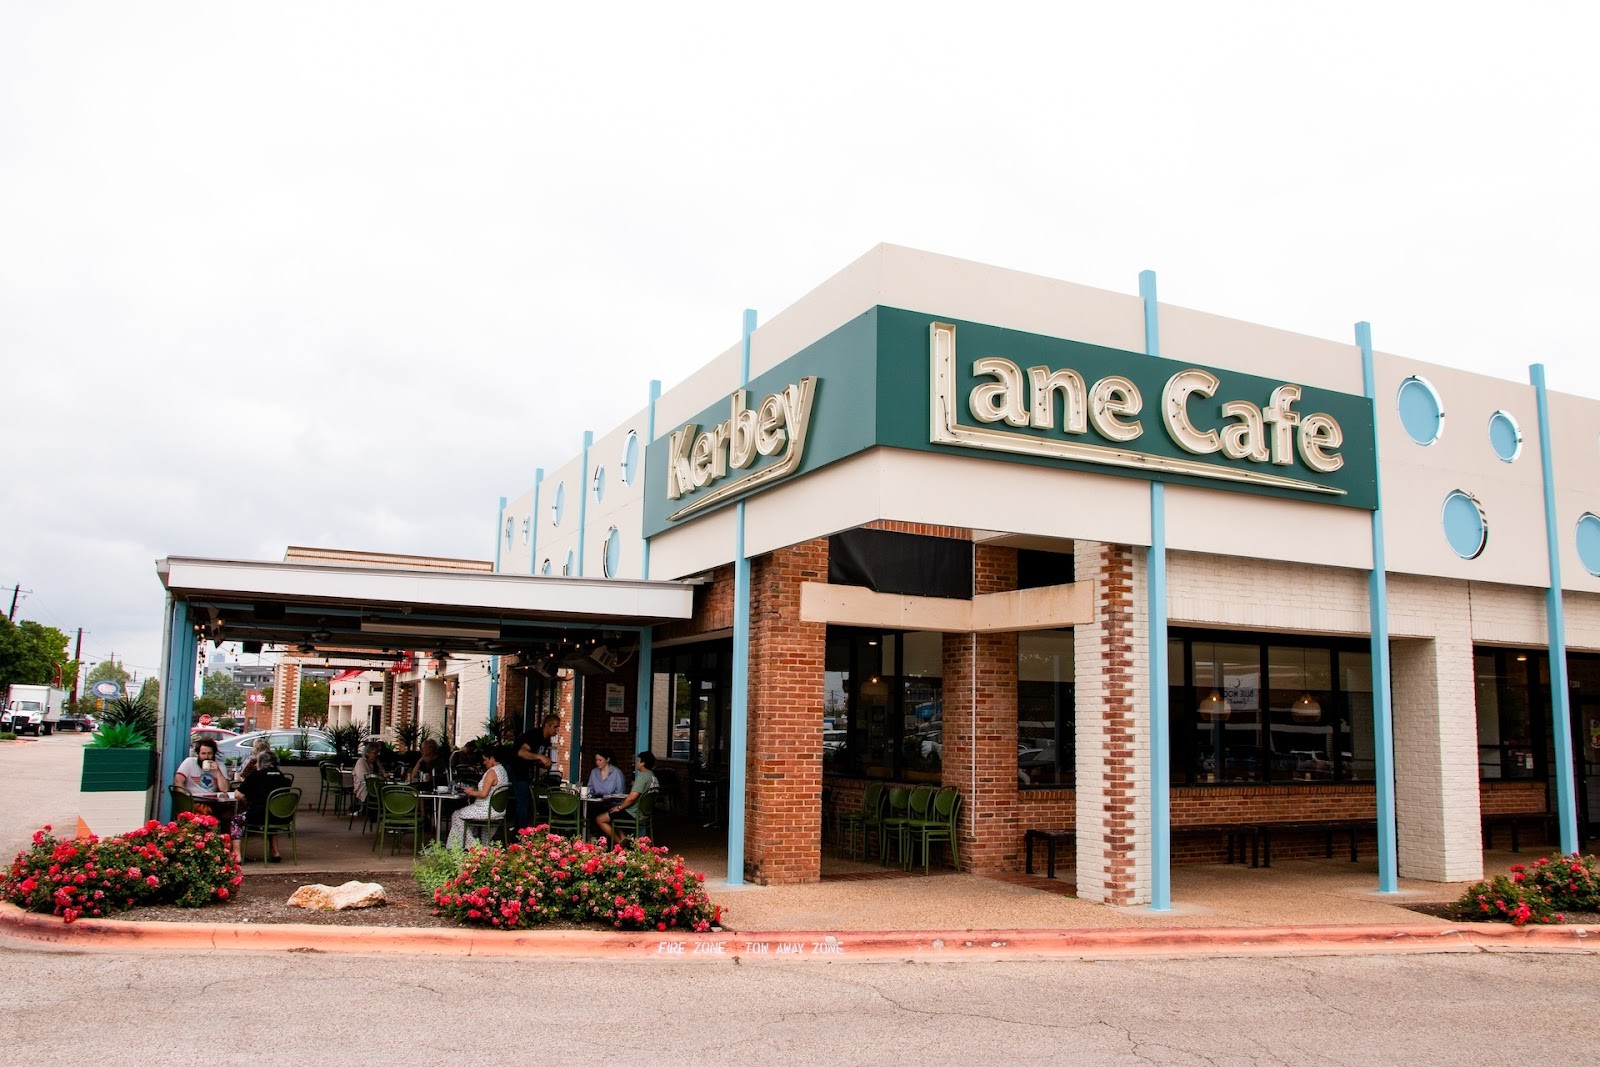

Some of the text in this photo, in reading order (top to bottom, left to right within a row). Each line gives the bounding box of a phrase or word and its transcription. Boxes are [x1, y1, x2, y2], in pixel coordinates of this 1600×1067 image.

[666, 374, 818, 502] Kerbey
[929, 321, 1346, 473] Lane Cafe
[658, 941, 845, 954] FIRE ZONE TOW AWAY ZONE
